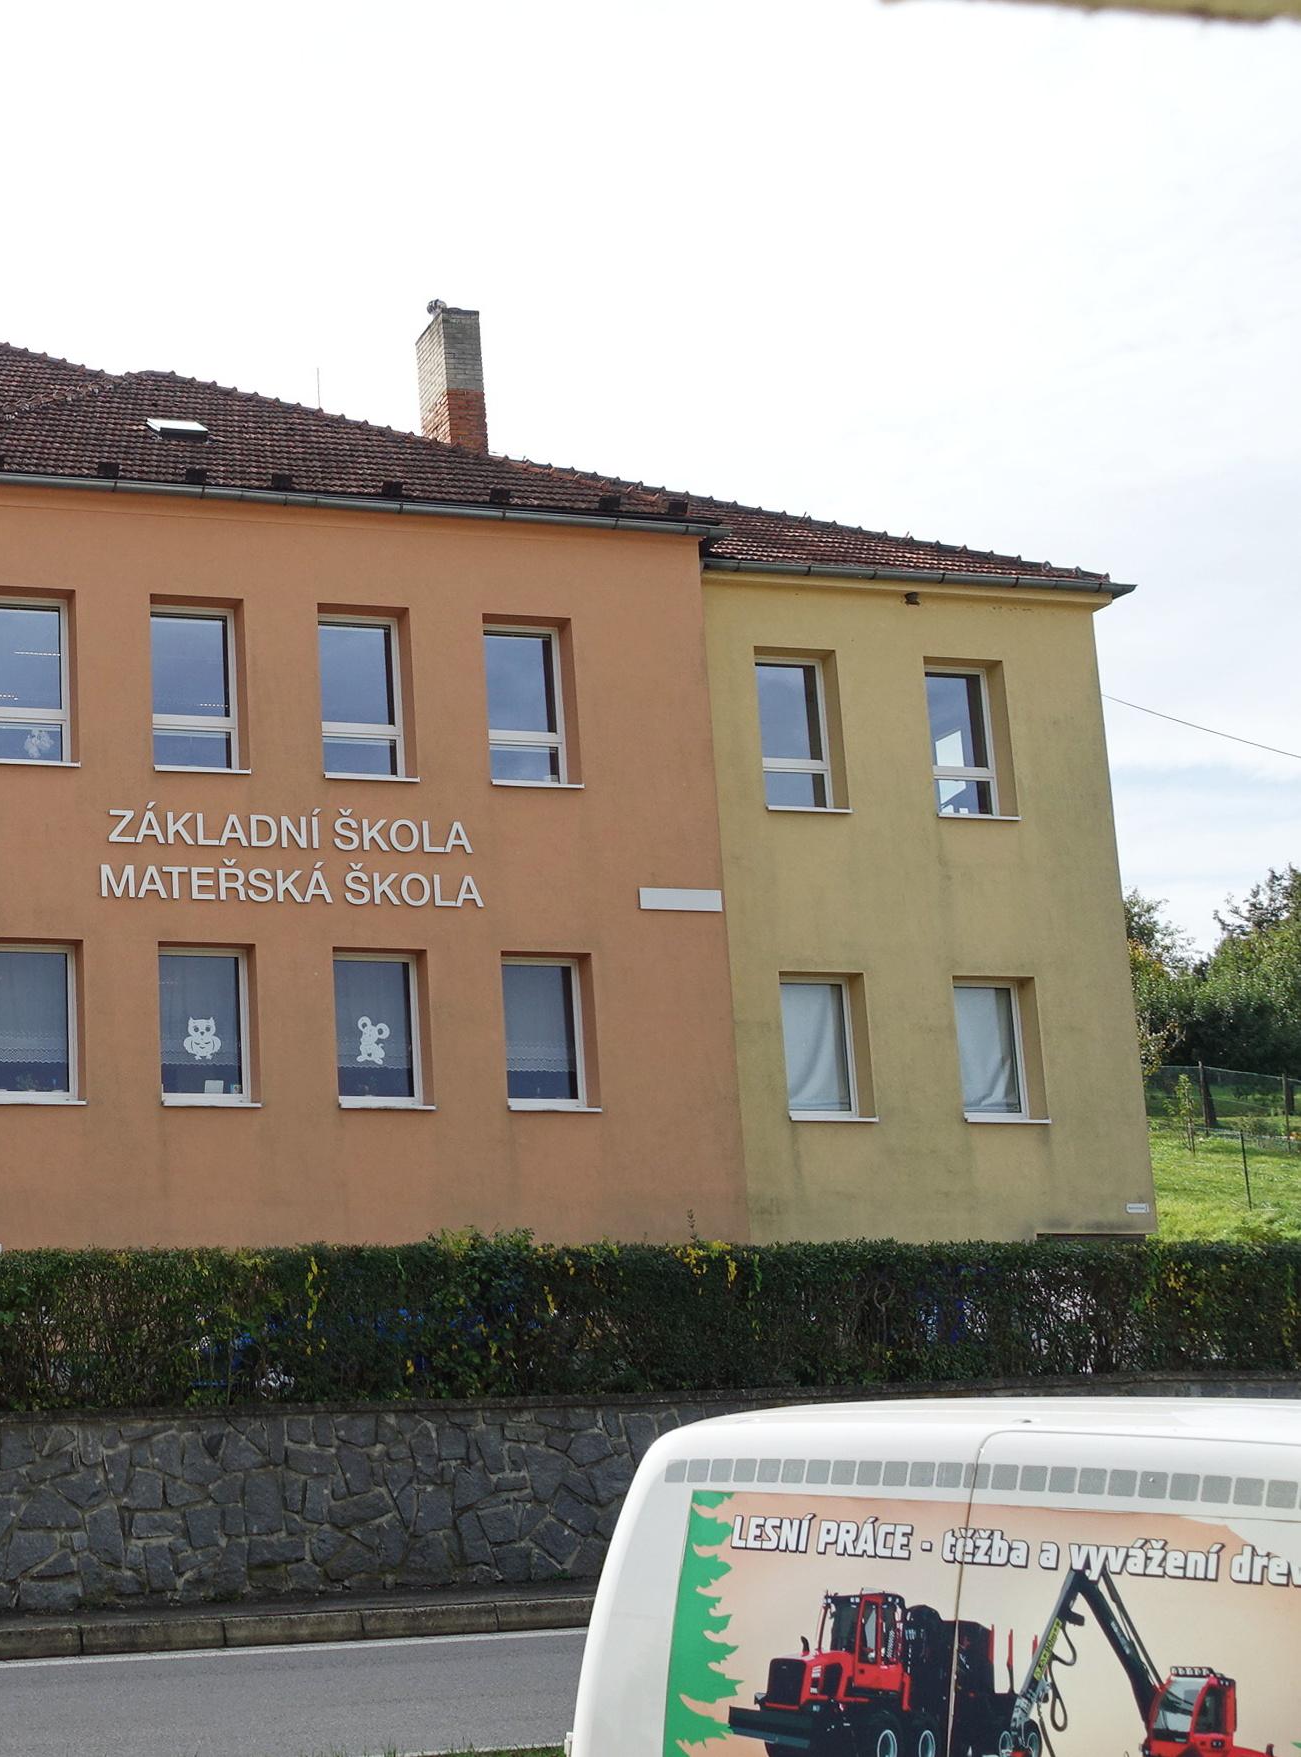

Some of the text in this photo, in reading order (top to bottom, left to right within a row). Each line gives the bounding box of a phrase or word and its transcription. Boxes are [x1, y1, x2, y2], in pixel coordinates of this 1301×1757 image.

[108, 801, 474, 854] ZÁKLADNÍ ŠKOLA
[100, 858, 485, 908] MATEŘSKÁ ŠKOLA
[730, 1513, 816, 1554] LESNÍ
[816, 1515, 914, 1560] PRÁCE
[941, 1527, 1030, 1568] těžba
[1038, 1541, 1060, 1570] a
[1069, 1537, 1225, 1582] vyvážení
